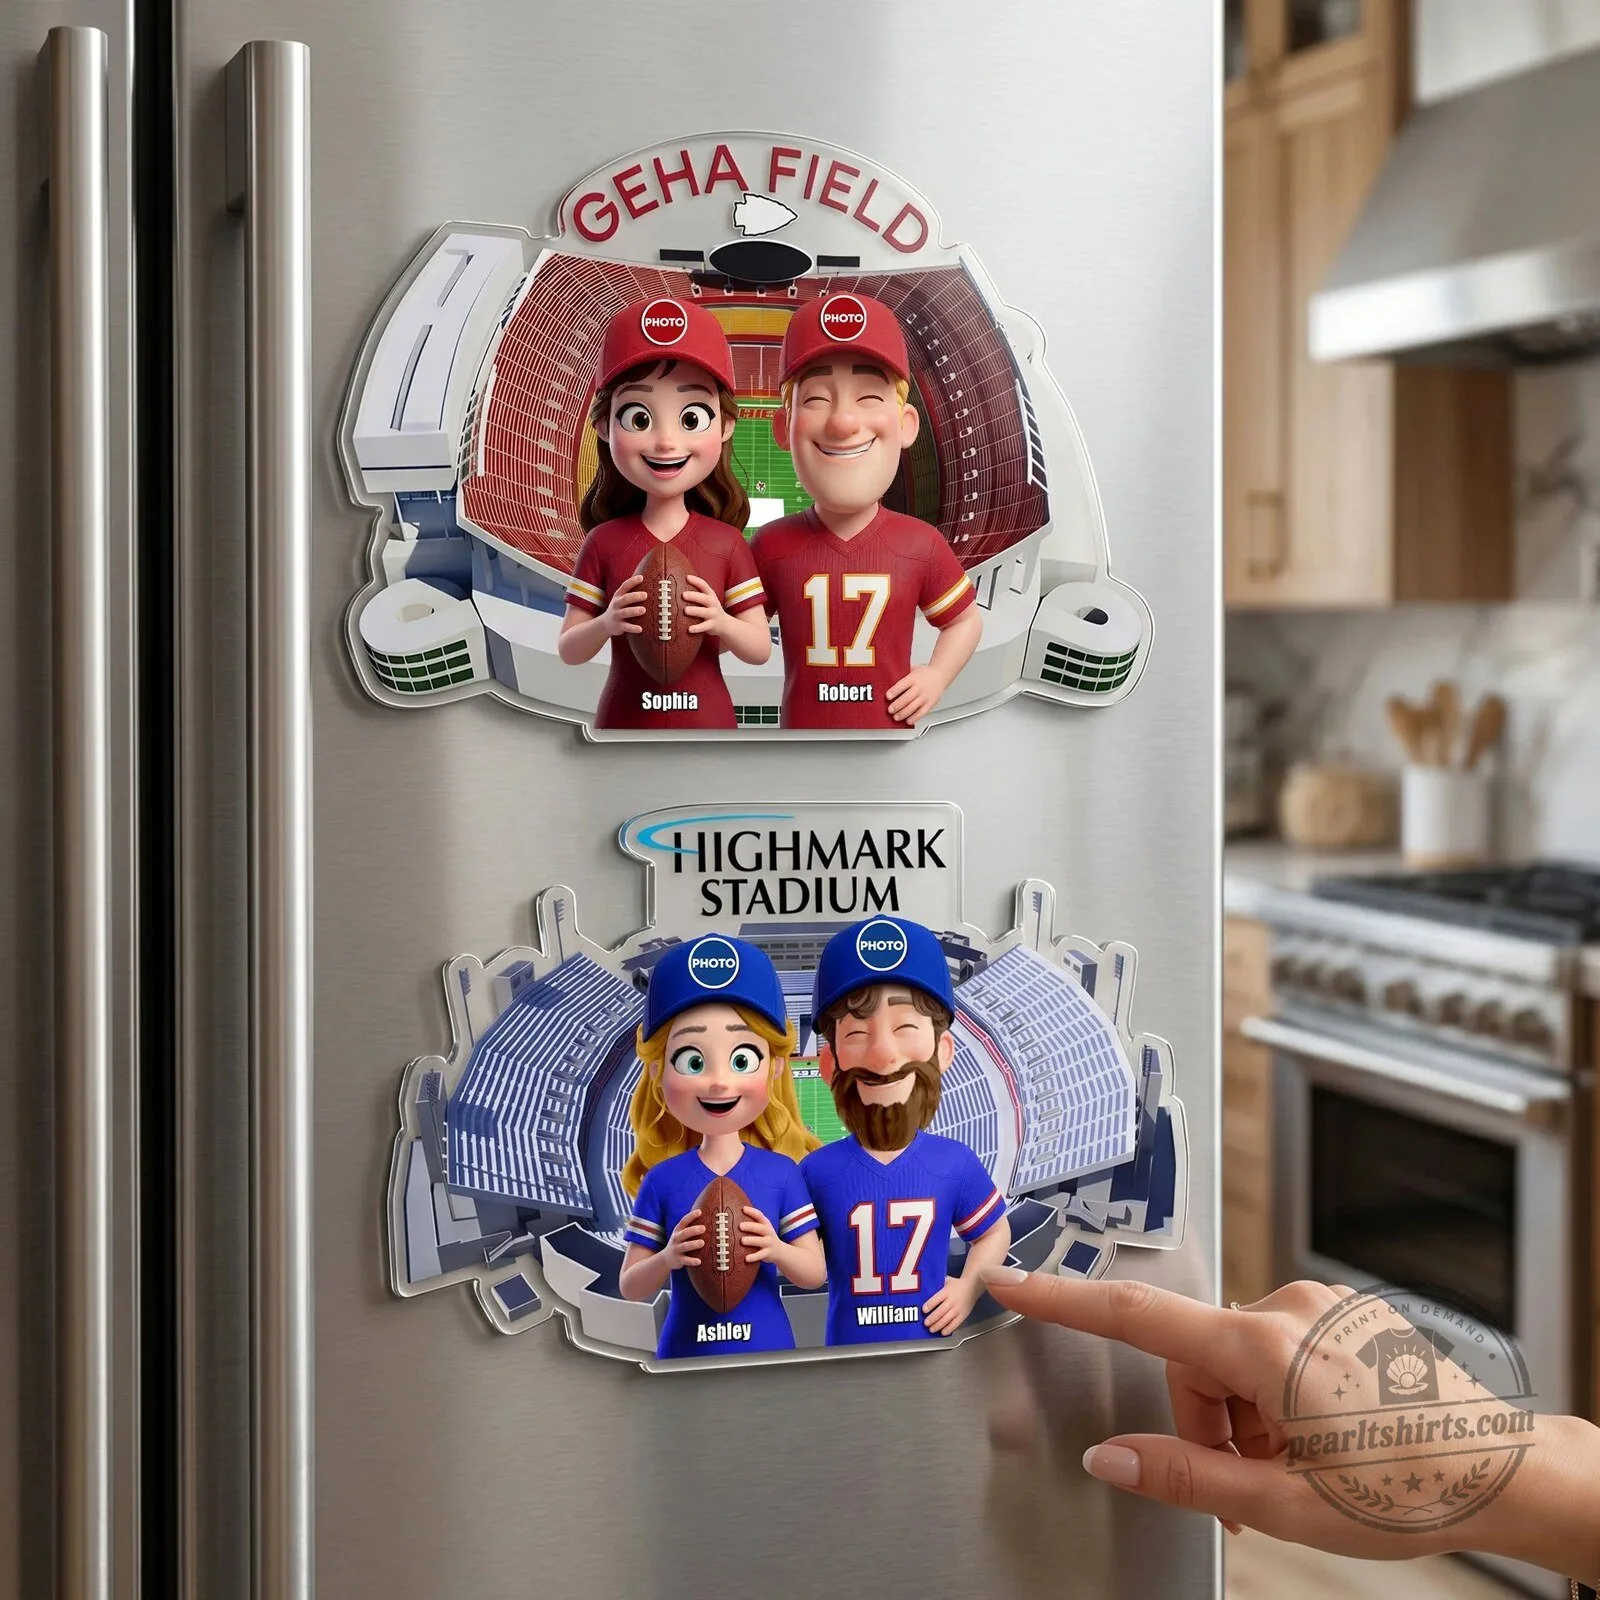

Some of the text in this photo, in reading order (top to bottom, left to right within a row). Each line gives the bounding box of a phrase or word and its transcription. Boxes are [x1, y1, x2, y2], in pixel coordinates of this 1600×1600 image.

[573, 144, 928, 253] GEHA FIELD
[645, 317, 685, 328] PHOTO
[824, 312, 864, 324] PHOTO
[804, 573, 890, 667] 17
[641, 692, 698, 711] Sophia
[818, 684, 873, 701] Robert
[673, 828, 946, 873] HIGHMARK
[701, 876, 900, 916] STADIUM
[860, 939, 904, 951] PHOTO
[692, 957, 735, 969] PHOTO
[848, 1198, 936, 1295] 17
[857, 1304, 919, 1326] William
[697, 1322, 751, 1343] Ashley
